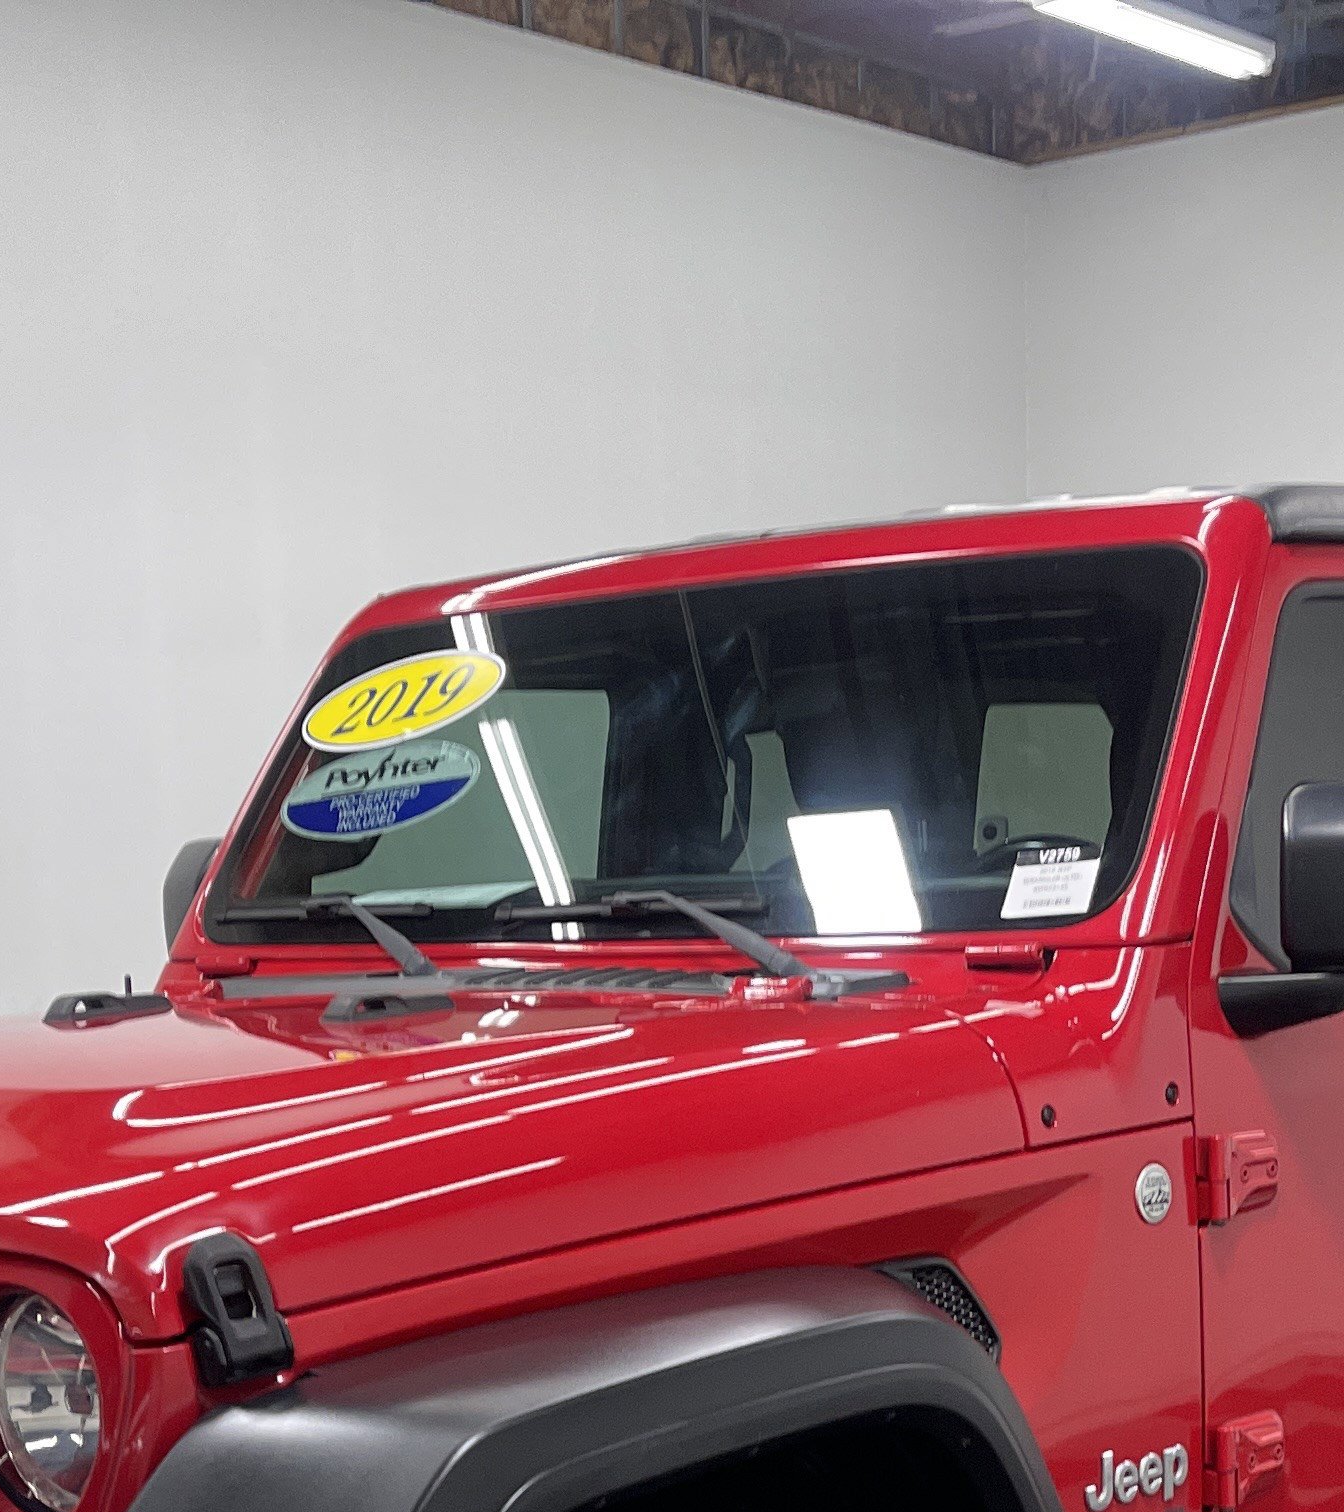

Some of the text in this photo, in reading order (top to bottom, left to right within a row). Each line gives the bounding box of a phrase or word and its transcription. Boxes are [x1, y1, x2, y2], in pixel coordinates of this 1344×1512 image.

[331, 664, 475, 737] 2019
[325, 748, 443, 790] Poynter
[1084, 1443, 1189, 1512] Jeep
